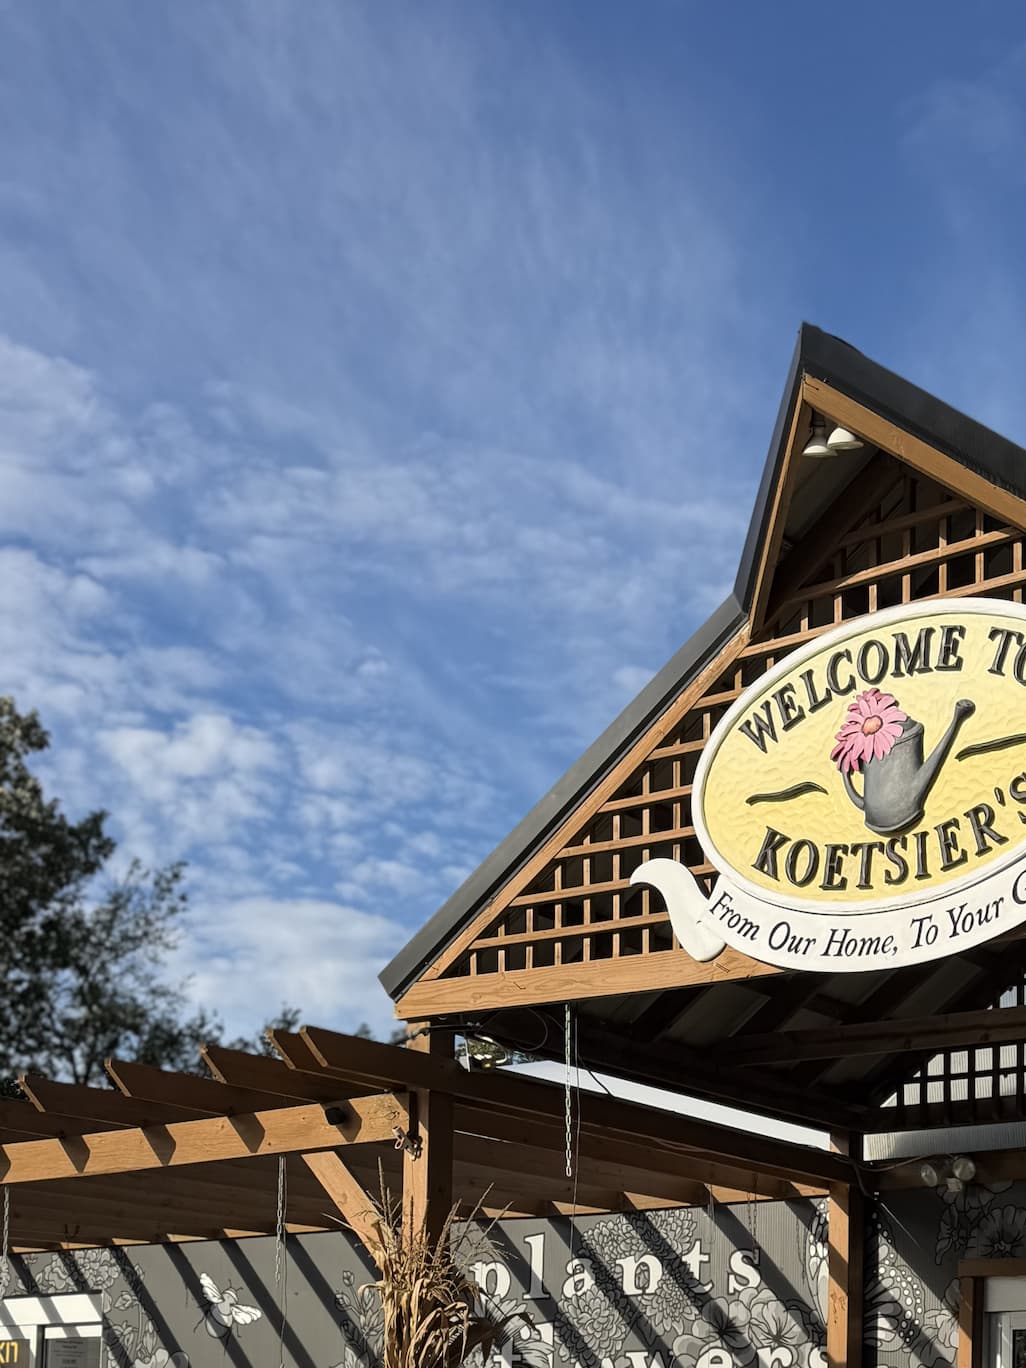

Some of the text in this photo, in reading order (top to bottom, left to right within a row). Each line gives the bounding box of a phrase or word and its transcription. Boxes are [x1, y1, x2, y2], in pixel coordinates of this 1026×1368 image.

[738, 624, 967, 753] WELCOME
[708, 891, 761, 942] From
[768, 921, 816, 955] Our
[820, 928, 898, 957] Home,
[910, 914, 939, 950] To
[946, 897, 1004, 938] Your
[469, 1232, 762, 1312] plants
